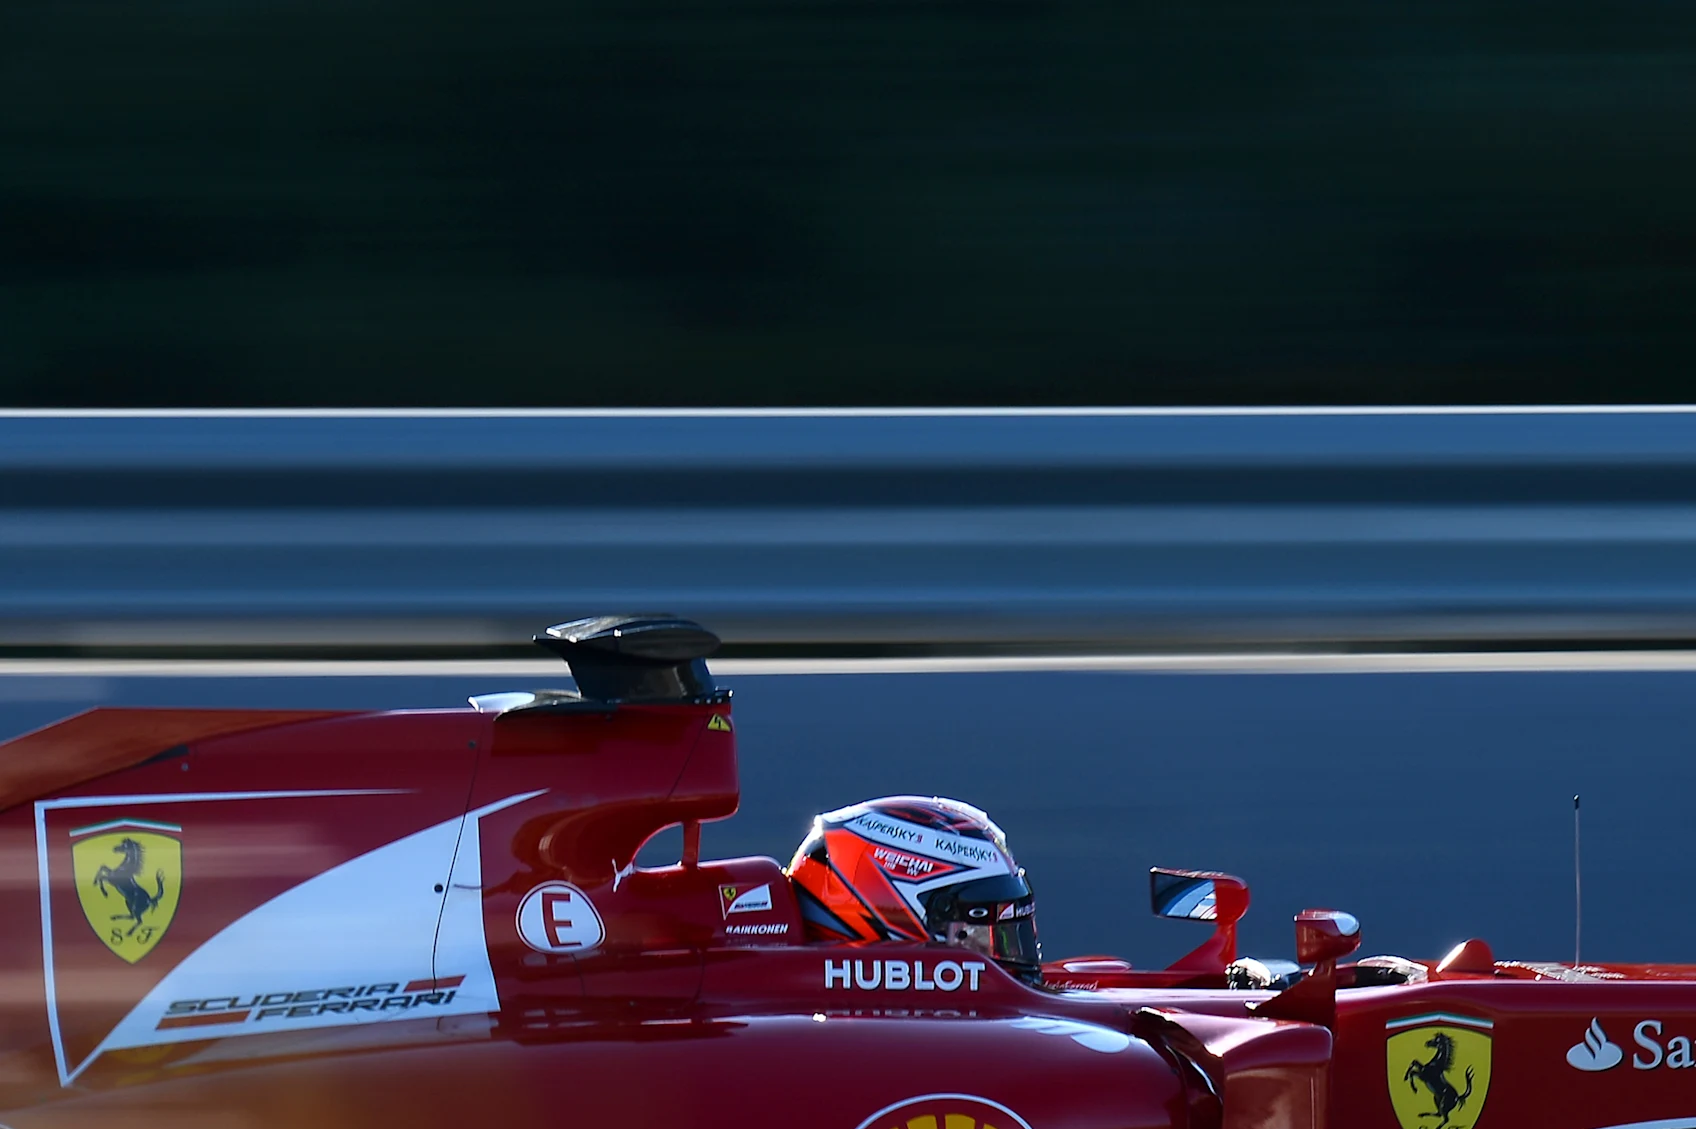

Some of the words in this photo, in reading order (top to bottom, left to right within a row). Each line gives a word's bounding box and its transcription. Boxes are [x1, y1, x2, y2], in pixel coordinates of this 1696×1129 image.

[855, 816, 916, 842] KASPERSKY
[873, 847, 934, 873] WEICHAI
[935, 838, 992, 862] KASPERSKY
[541, 891, 583, 948] E
[824, 959, 985, 991] HUBLOT
[165, 983, 399, 1015] SCUDERIA
[254, 991, 456, 1021] FERRARI
